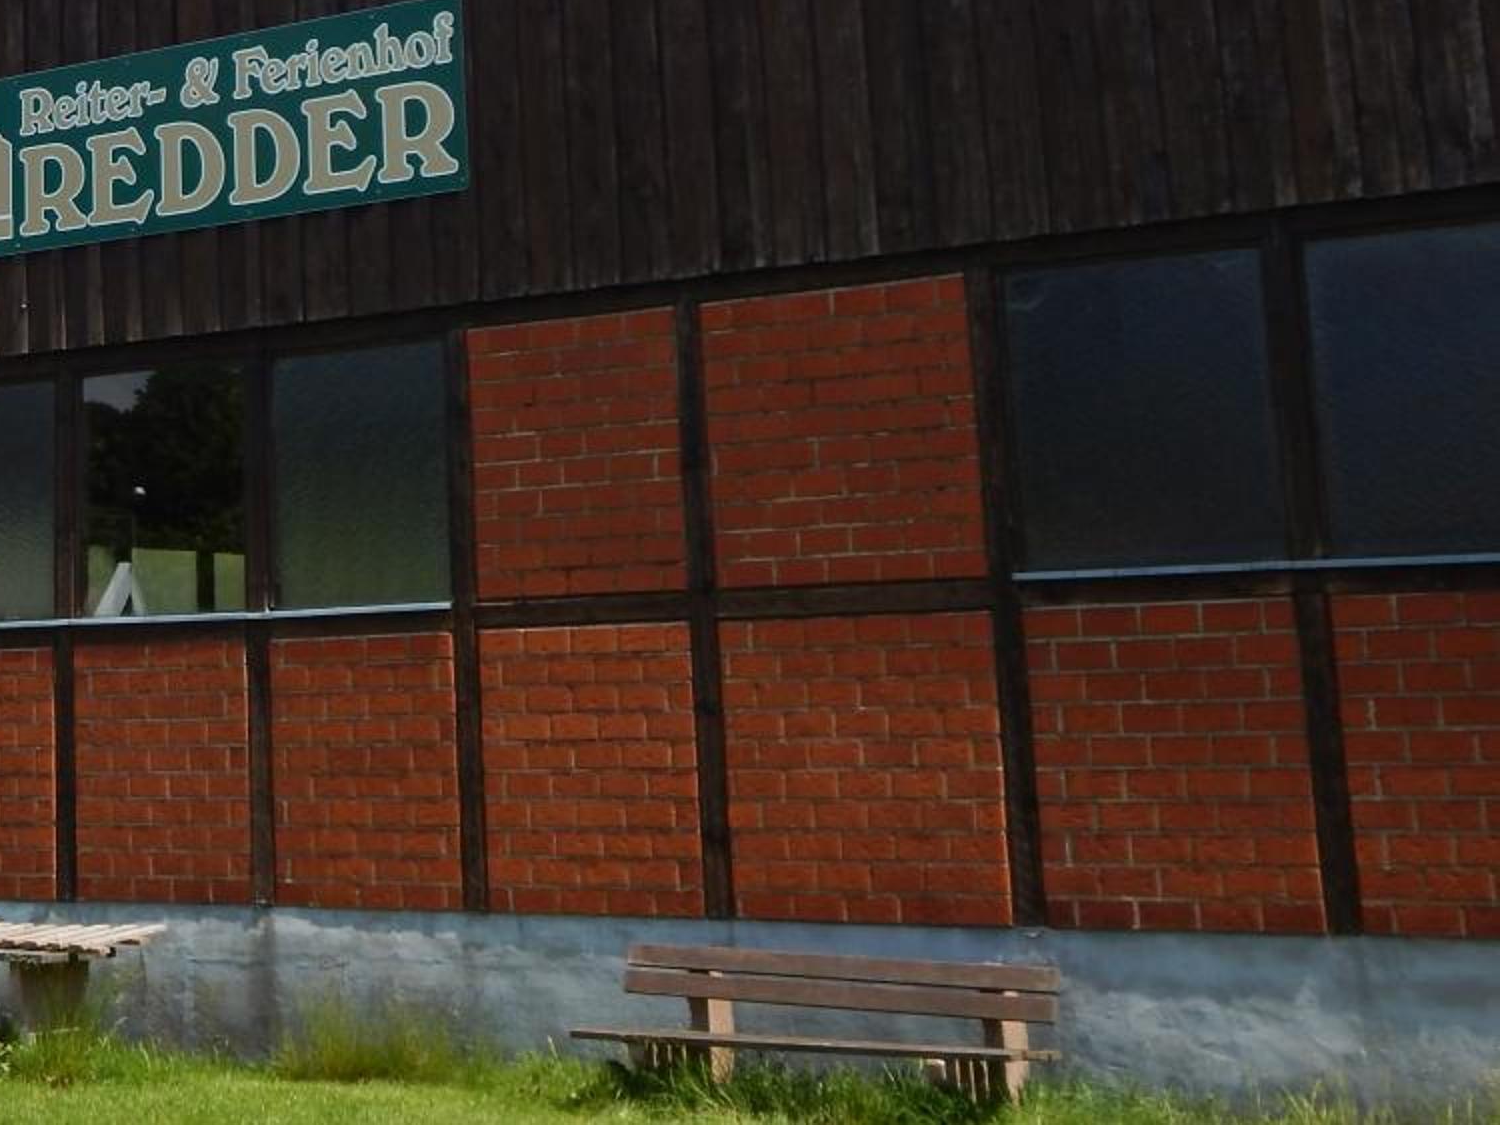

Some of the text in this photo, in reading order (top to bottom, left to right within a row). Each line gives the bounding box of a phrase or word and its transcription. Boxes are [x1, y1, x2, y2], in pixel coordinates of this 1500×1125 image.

[19, 11, 454, 135] Reiter- & Ferienhof
[19, 81, 459, 236] REDDER
